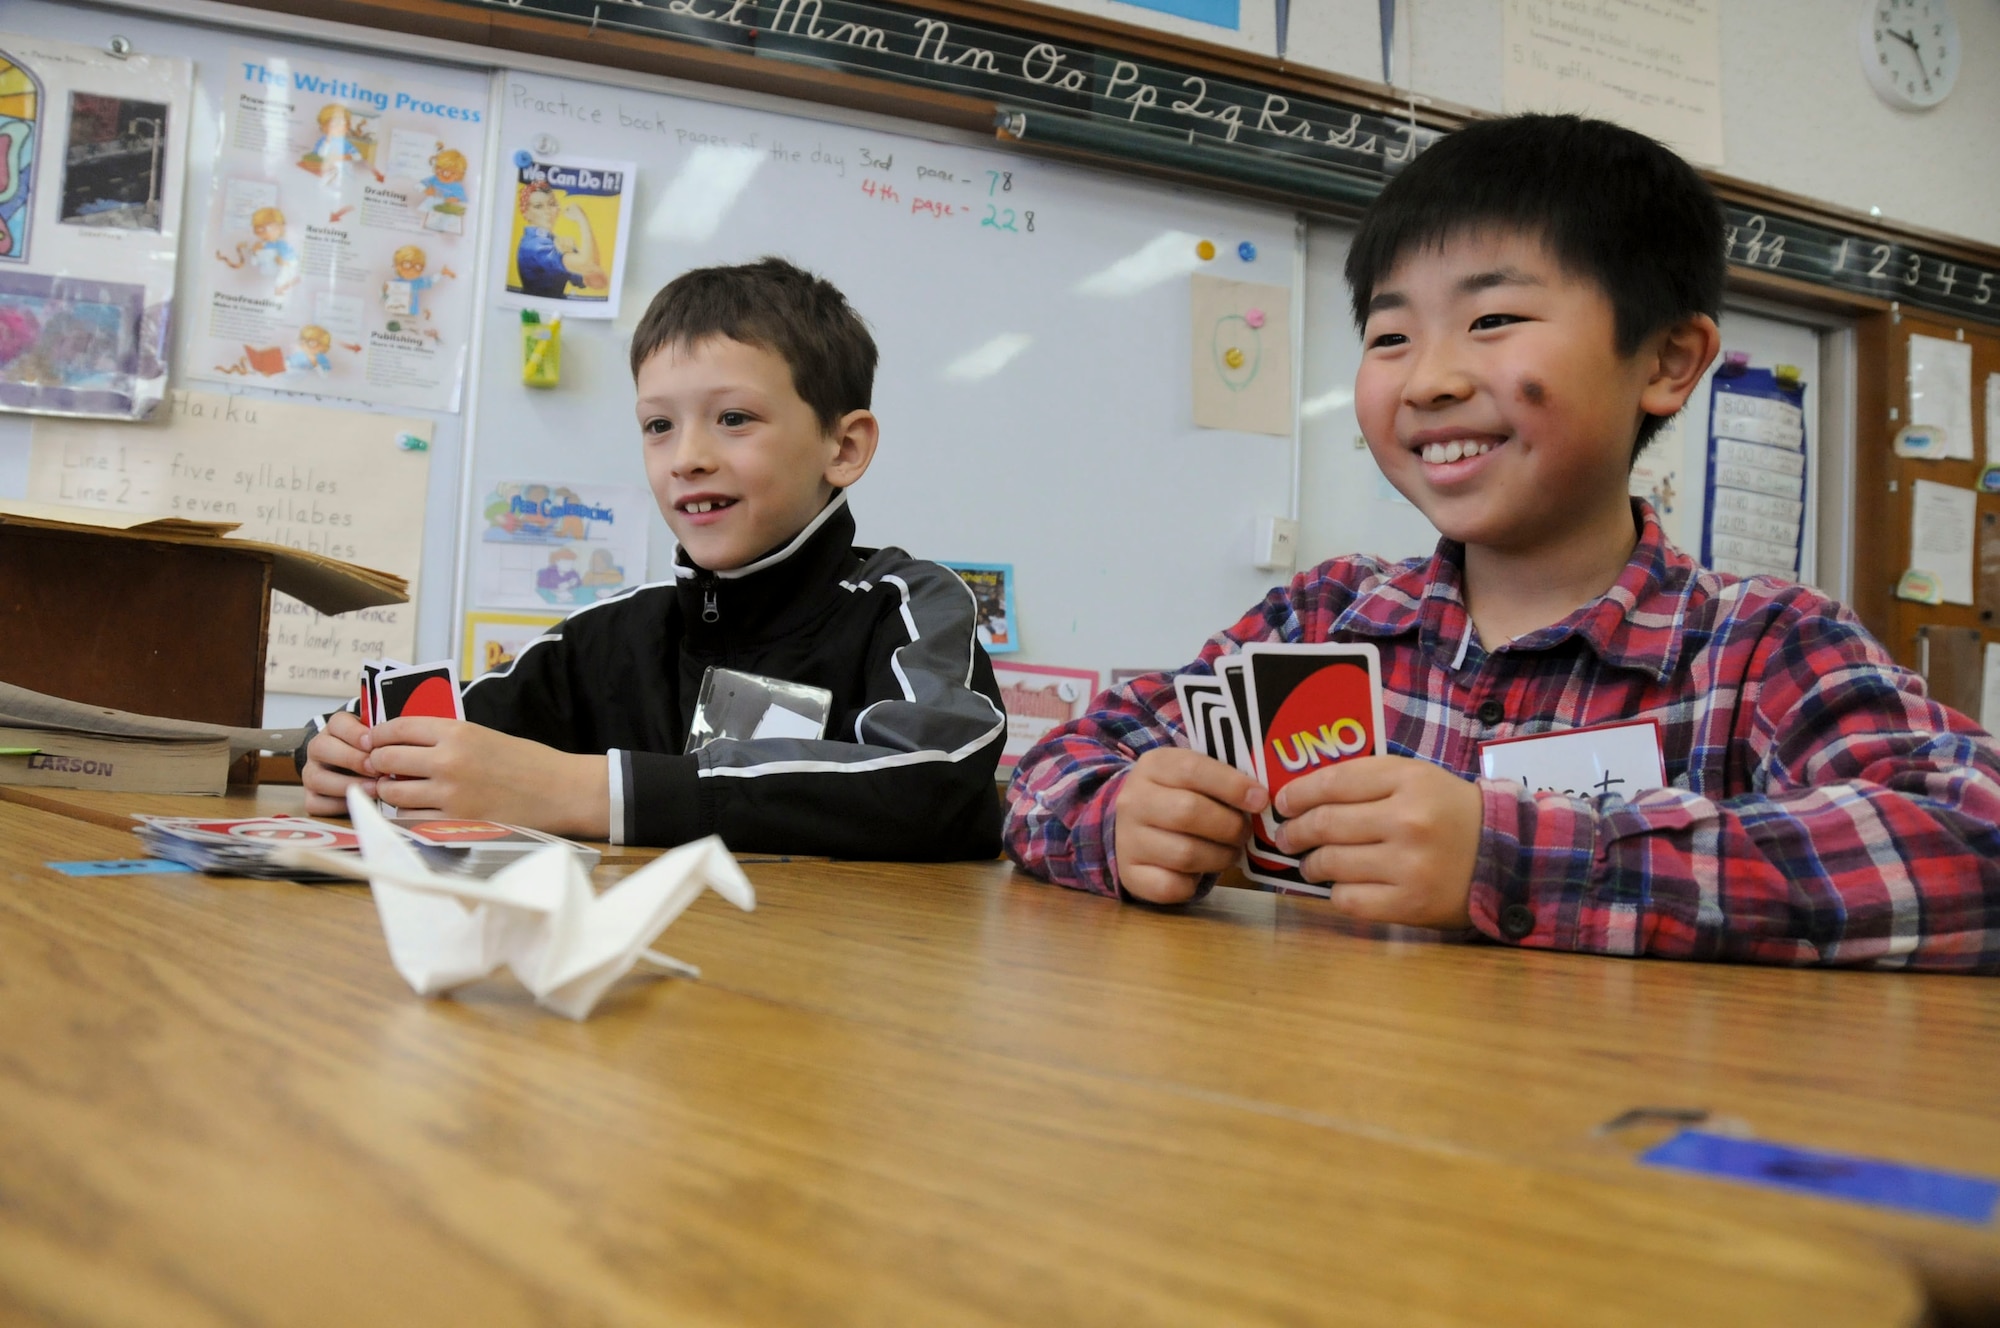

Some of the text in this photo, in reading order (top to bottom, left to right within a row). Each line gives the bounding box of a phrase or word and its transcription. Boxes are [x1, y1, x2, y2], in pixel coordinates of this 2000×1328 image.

[242, 62, 288, 89] The
[294, 71, 389, 111] Writing
[395, 92, 481, 123] Process
[771, 0, 888, 51] Mm
[914, 18, 999, 73] Nn
[1022, 42, 1086, 91] Oo
[1105, 60, 1157, 121] Pp
[1257, 94, 1314, 141] Rr
[1325, 113, 1377, 154] Ss
[1385, 96, 1433, 162] T
[512, 83, 602, 124] Practice
[619, 104, 666, 135] book
[769, 141, 801, 163] the
[811, 142, 845, 177] day
[523, 163, 622, 191] We Can Do It!
[858, 148, 893, 171] 3rd
[985, 170, 1012, 196] 78
[364, 186, 408, 201] Drafting
[861, 178, 899, 203] 4th
[911, 196, 954, 218] page
[306, 225, 348, 239] Revising
[1832, 238, 1849, 272] 1
[1868, 244, 1891, 279] 2
[1905, 253, 1921, 286] 3
[1936, 262, 1957, 297] 4
[1973, 272, 1994, 305] 5
[214, 291, 282, 311] Proofreading
[371, 330, 423, 347] Publishing
[168, 391, 258, 424] Haiku
[62, 440, 108, 471] Line
[170, 452, 215, 482] five
[234, 463, 337, 494] syllables
[59, 472, 108, 502] Line
[116, 479, 131, 503] 2
[171, 494, 237, 515] seven
[256, 498, 352, 528] syllabes
[278, 623, 384, 661] his lonely song
[288, 664, 351, 682] summer
[1271, 717, 1367, 773] UNO
[27, 755, 114, 777] LARSON
